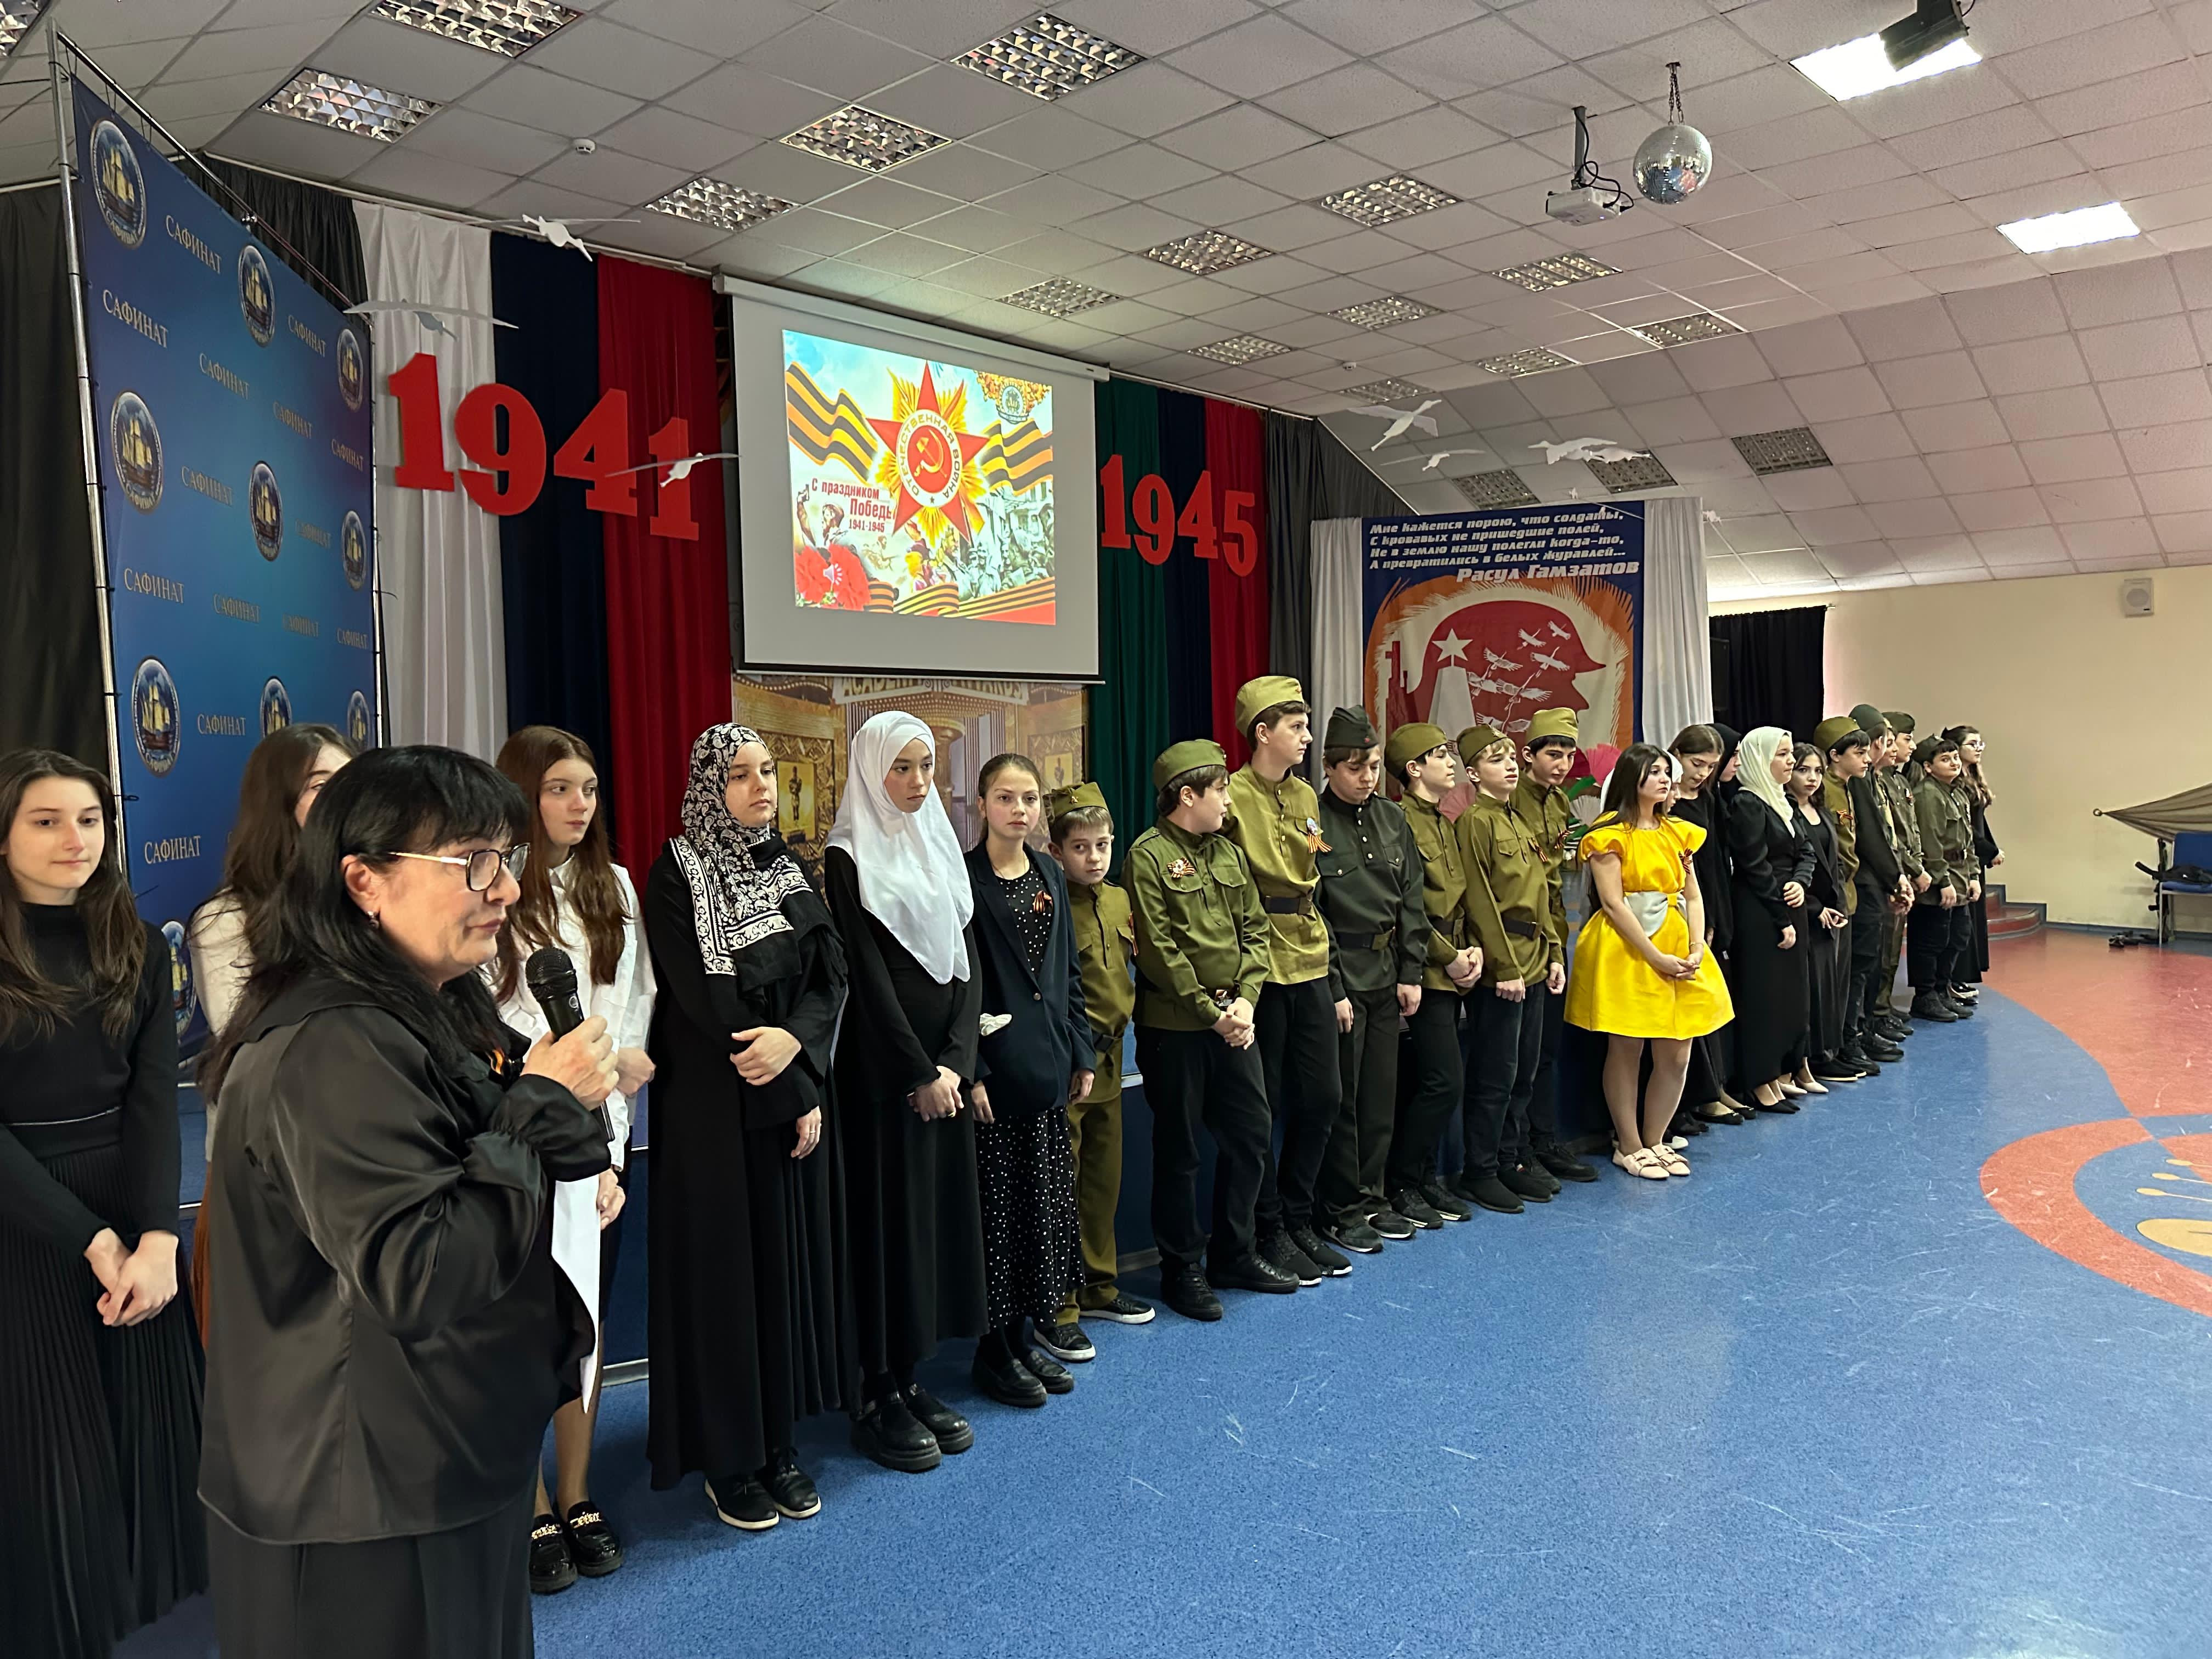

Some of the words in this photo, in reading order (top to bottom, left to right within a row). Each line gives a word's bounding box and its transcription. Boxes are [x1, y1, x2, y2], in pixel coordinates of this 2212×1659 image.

[166, 215, 221, 274] САФИНАТ
[103, 289, 168, 348] САФИНАТ
[288, 315, 326, 357] САФИНАТ
[199, 353, 250, 399] САФИНАТ
[273, 401, 312, 439] САФИНАТ
[331, 439, 364, 472] САФИНАТ
[388, 352, 699, 541] 1941
[900, 414, 955, 496] ОТЕЧЕСТВЕННАЯ
[181, 466, 233, 507] САФИНАТ
[812, 478, 818, 492] С
[822, 481, 879, 500] праздником
[850, 498, 895, 520] Победы
[1100, 454, 1258, 577] 1945
[1369, 524, 1398, 534] Мне
[1402, 521, 1463, 533] кажется
[1466, 518, 1517, 529] порою,
[1521, 515, 1550, 525] что
[1554, 511, 1624, 523] солдаты,
[849, 518, 885, 533] 1941-1945
[1370, 537, 1378, 546] С
[1381, 533, 1448, 546] кровавых
[1452, 532, 1468, 541] не
[1471, 527, 1554, 541] пришедшие
[1558, 523, 1604, 534] полей,
[1369, 560, 1379, 569] А
[1382, 555, 1479, 569] превратились
[1482, 555, 1491, 563] в
[1494, 552, 1538, 563] белых
[1543, 547, 1626, 561] журавлей...
[1370, 548, 1387, 557] Не
[1402, 546, 1447, 556] землю
[1451, 543, 1488, 554] нашу
[1492, 539, 1546, 551] полегли
[124, 568, 184, 604] САФИНАТ
[1456, 567, 1520, 584] Расул
[1527, 561, 1640, 579] Гамзатов
[213, 593, 260, 623] САФИНАТ
[337, 628, 368, 650] САФИНАТ
[198, 714, 246, 736] САФИНАТ
[144, 836, 201, 865] САФИНАТ
